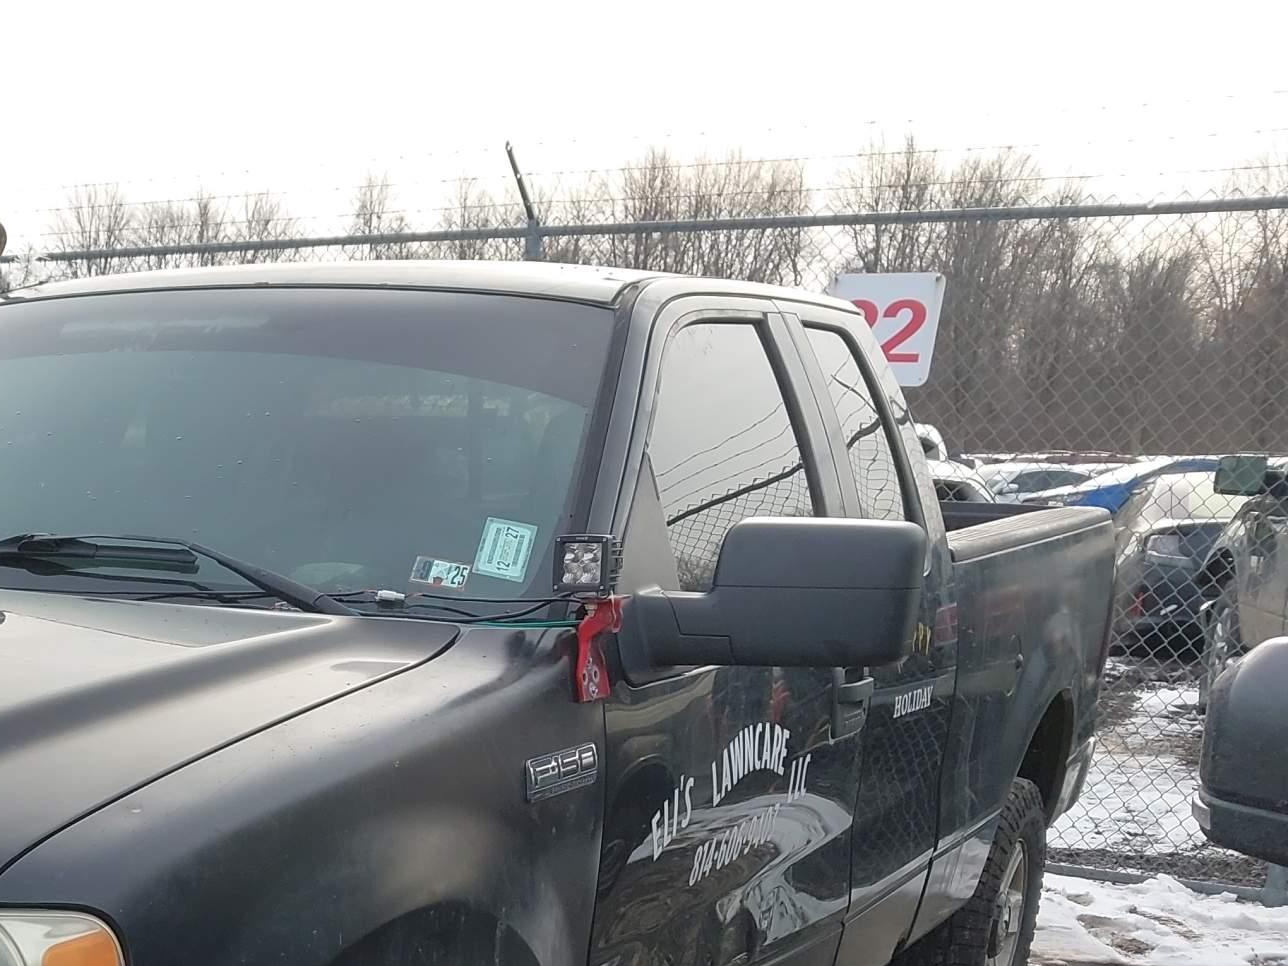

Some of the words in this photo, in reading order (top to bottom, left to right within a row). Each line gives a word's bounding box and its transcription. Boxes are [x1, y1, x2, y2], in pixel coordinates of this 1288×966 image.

[505, 526, 520, 540] 27
[450, 565, 469, 586] 25
[893, 686, 933, 719] HOLIDAY
[651, 774, 695, 862] ELI'S
[711, 721, 791, 808] LAWNCARE
[787, 753, 812, 803] LLC
